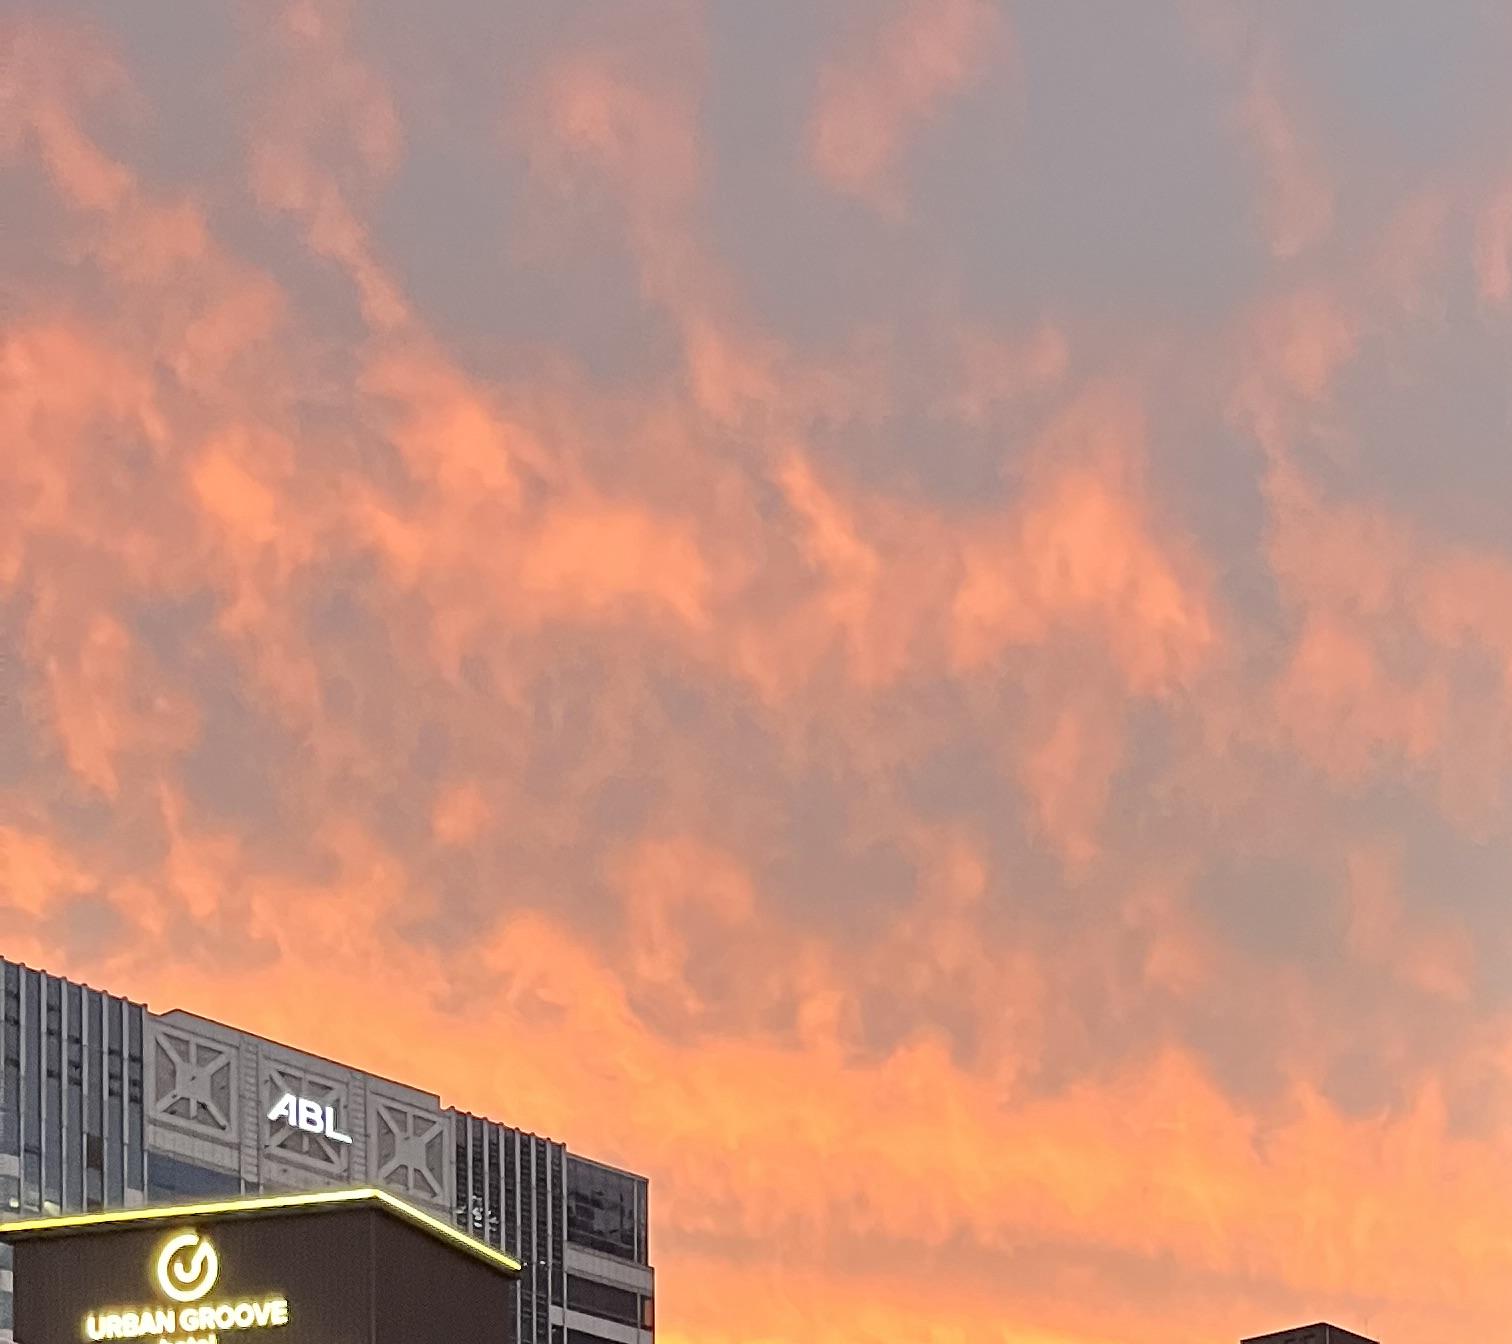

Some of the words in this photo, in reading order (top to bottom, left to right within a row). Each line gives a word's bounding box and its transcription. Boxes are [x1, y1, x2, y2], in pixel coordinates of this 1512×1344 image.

[267, 1093, 352, 1144] ABL
[86, 1309, 176, 1341] URBAN
[179, 1299, 289, 1332] GROOVE
